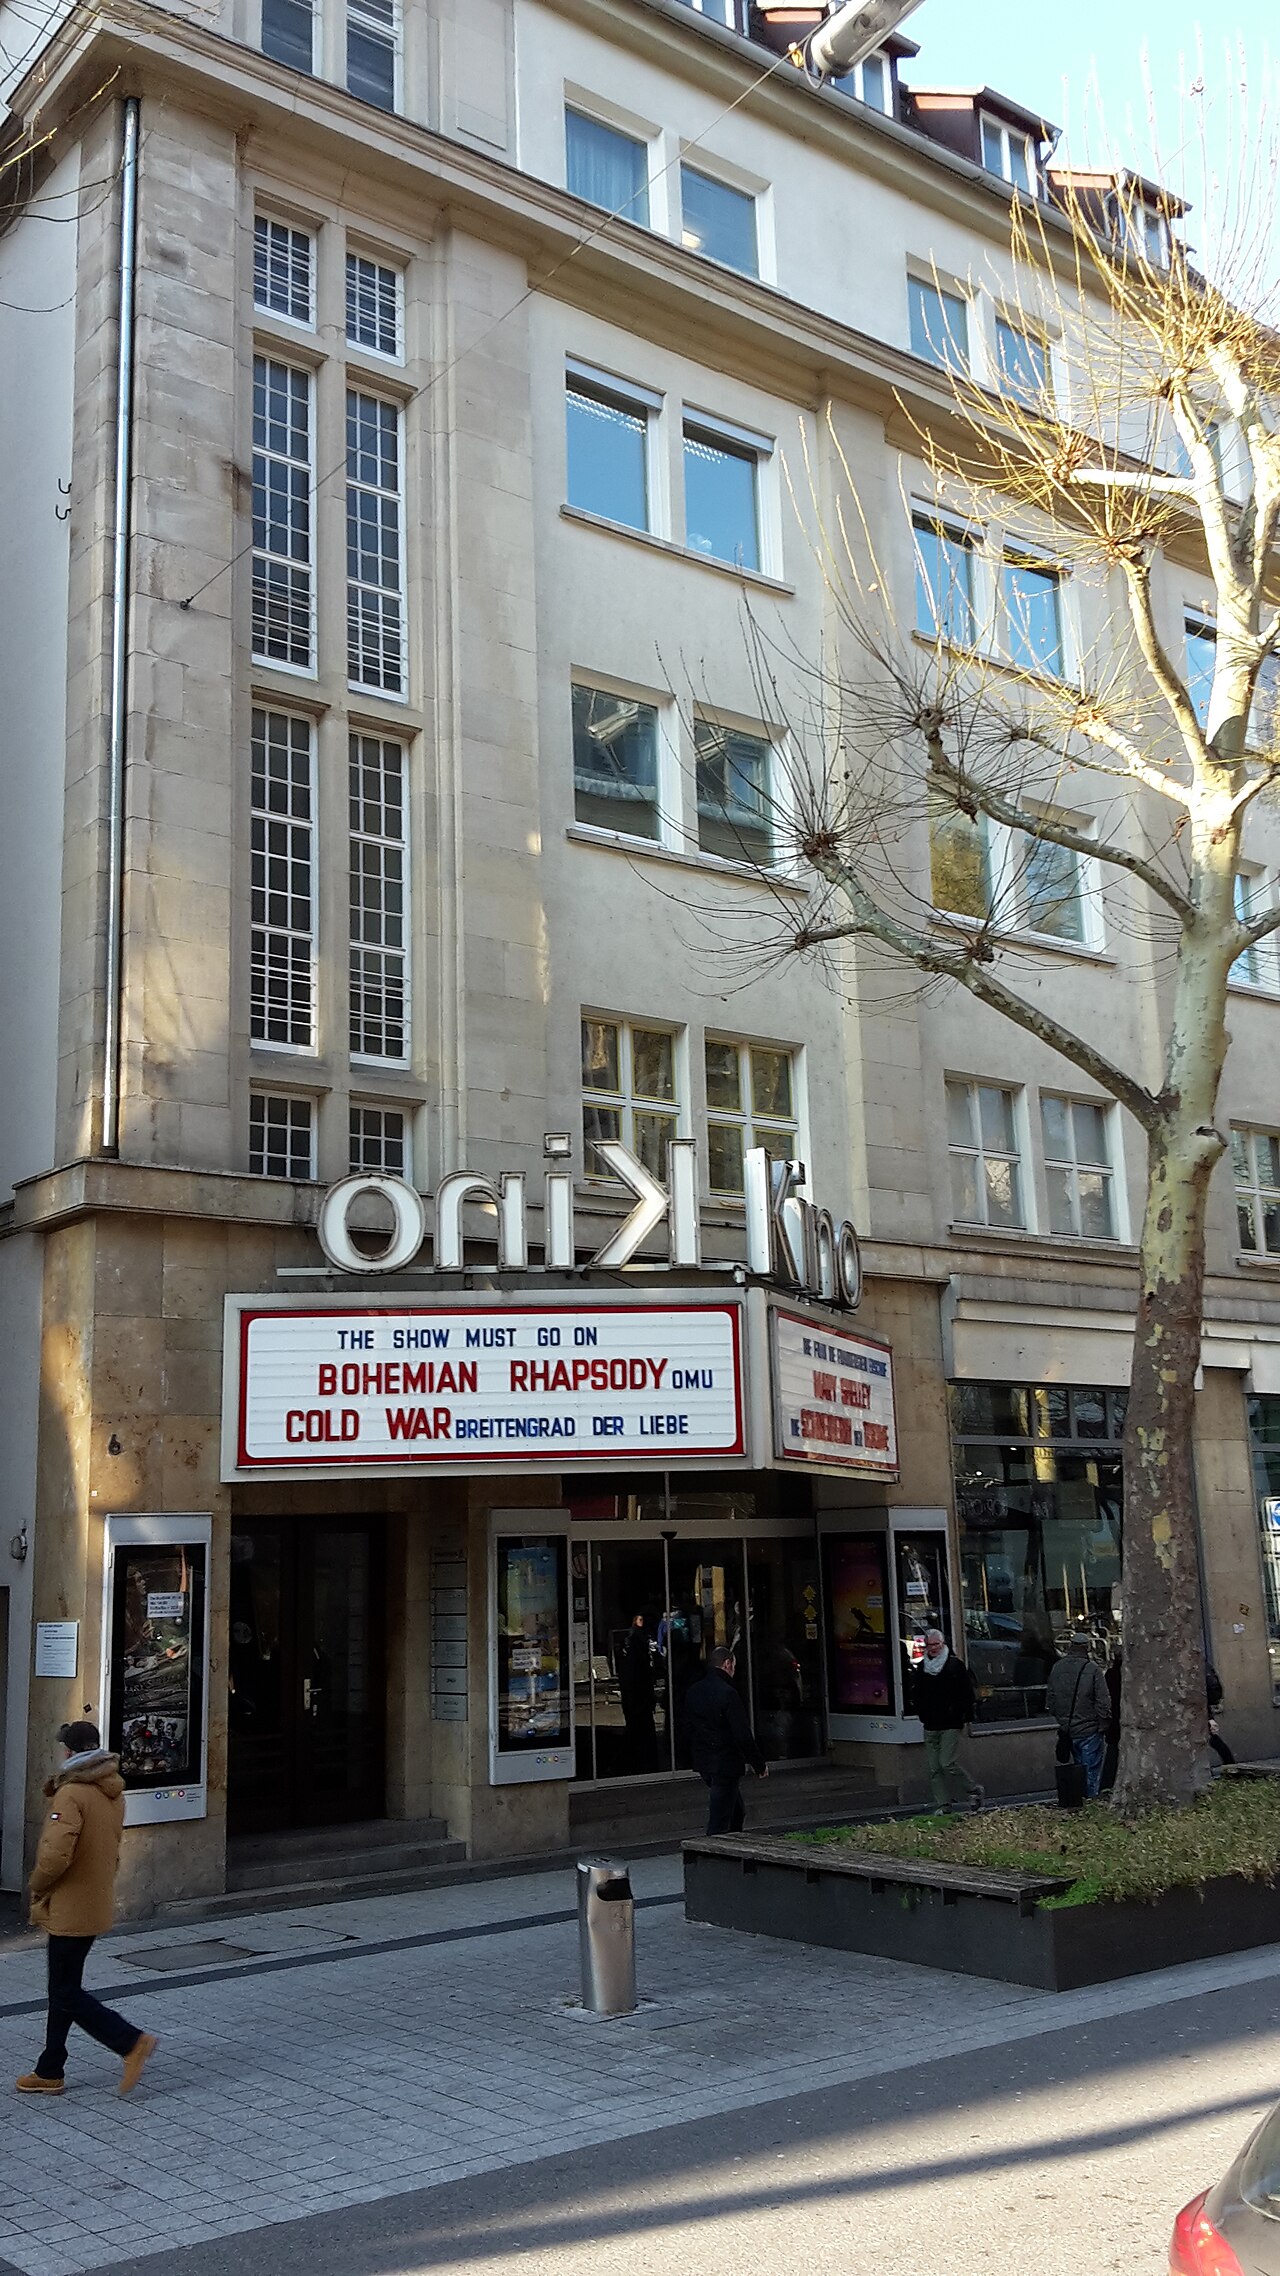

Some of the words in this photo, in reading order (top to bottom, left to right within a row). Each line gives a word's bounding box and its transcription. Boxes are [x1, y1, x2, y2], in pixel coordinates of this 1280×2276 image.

[337, 1330, 375, 1349] THE
[393, 1329, 450, 1348] SHOW
[466, 1328, 517, 1347] MUST
[537, 1327, 560, 1347] GO
[574, 1326, 597, 1346] ON
[318, 1361, 478, 1395] BOHEMIAN
[510, 1358, 668, 1392] RHAPSODY
[672, 1369, 713, 1389] OMU
[286, 1409, 360, 1442] COLD
[386, 1407, 451, 1440] WAR
[455, 1417, 576, 1439] BREITENGRAD
[592, 1416, 624, 1436] DER
[640, 1414, 689, 1435] LIEBE
